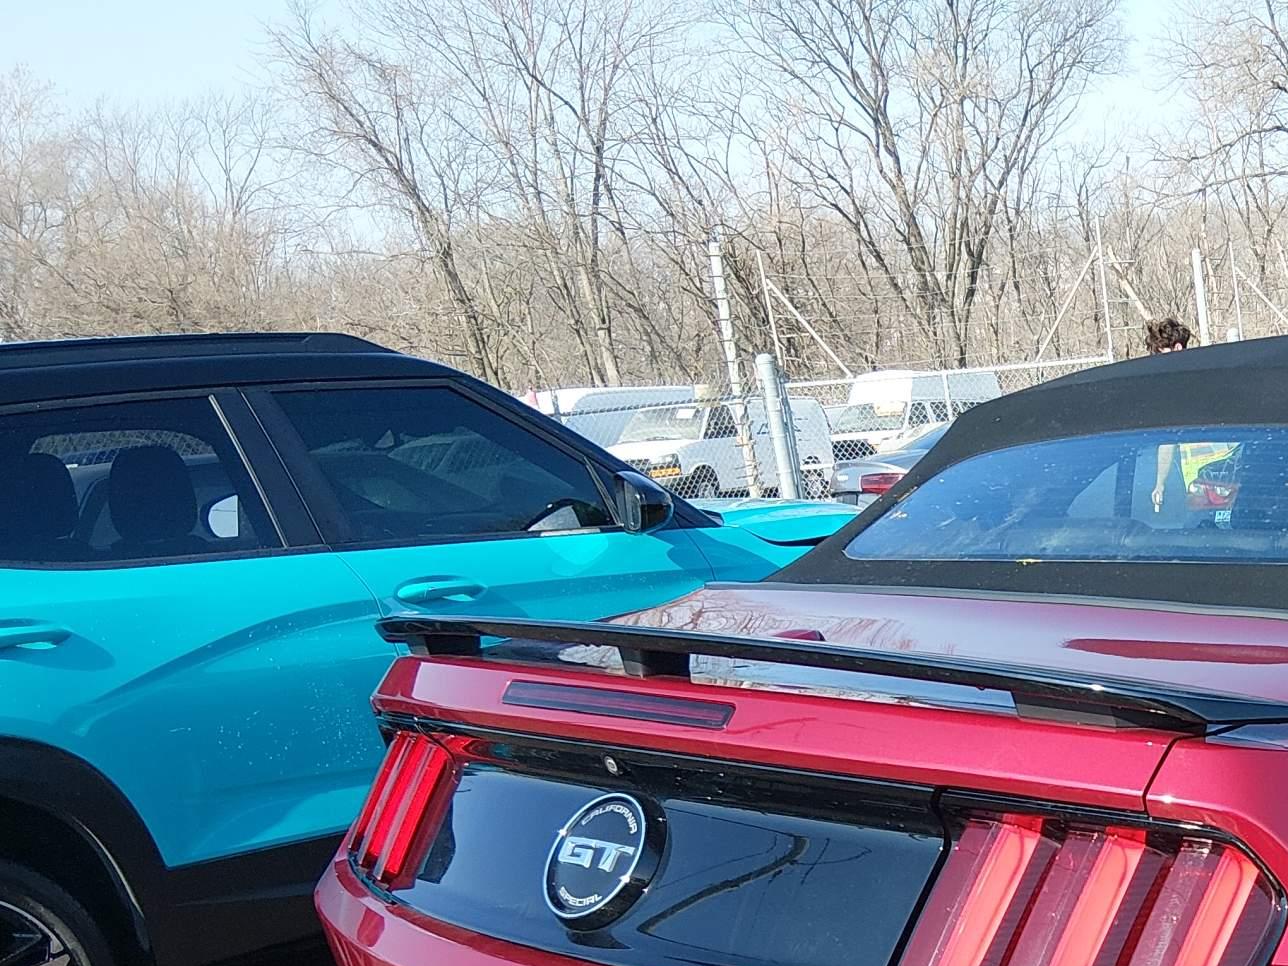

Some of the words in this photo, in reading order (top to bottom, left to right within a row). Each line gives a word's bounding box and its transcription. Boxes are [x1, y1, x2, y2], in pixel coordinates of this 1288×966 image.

[581, 804, 638, 834] CALIFORNIA
[557, 836, 636, 873] GT
[559, 886, 603, 907] SPECIAL
